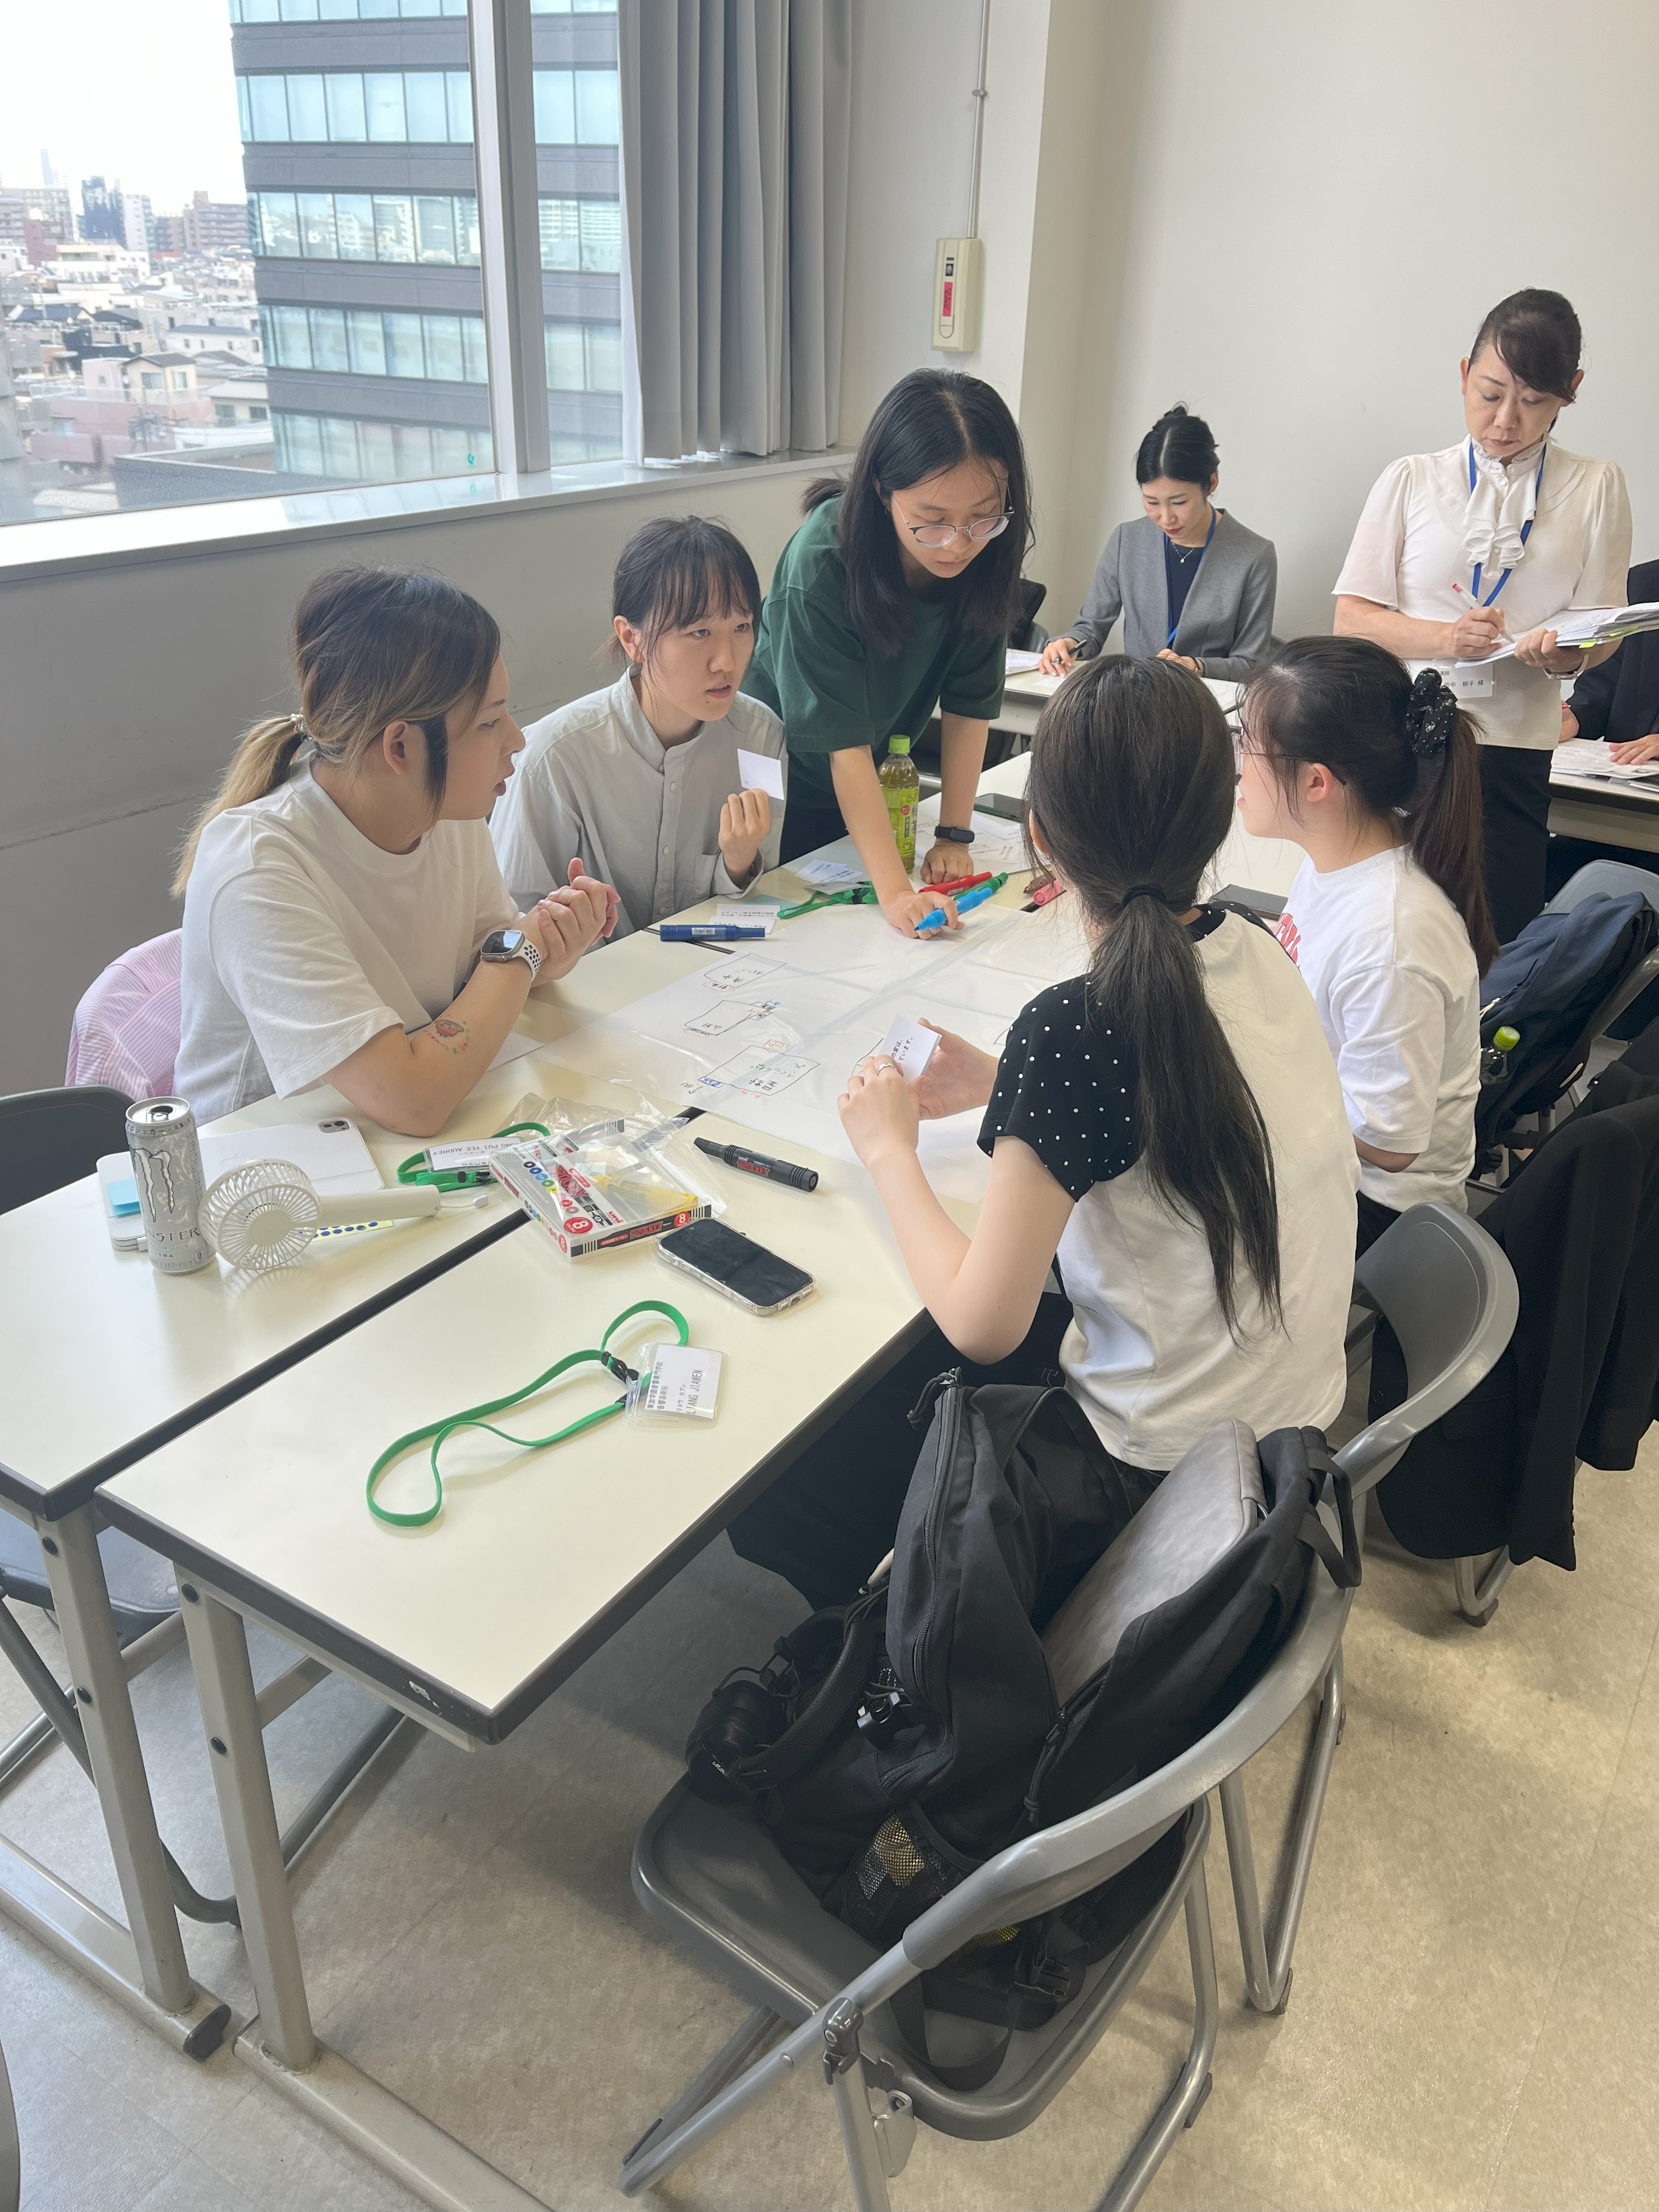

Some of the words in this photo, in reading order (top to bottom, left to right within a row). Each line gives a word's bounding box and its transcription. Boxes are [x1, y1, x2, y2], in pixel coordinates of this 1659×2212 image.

[433, 1147, 462, 1155] AUDREY
[737, 1159, 770, 1176] PROCKEY
[546, 1165, 589, 1198] PROCY
[572, 1221, 589, 1229] 8
[609, 1211, 623, 1223] uni
[679, 1213, 686, 1223] 8
[148, 1227, 200, 1243] NSTER
[630, 1221, 663, 1239] PROCKEY
[690, 1369, 702, 1391] JIAWEN
[686, 1395, 698, 1414] LIANG
